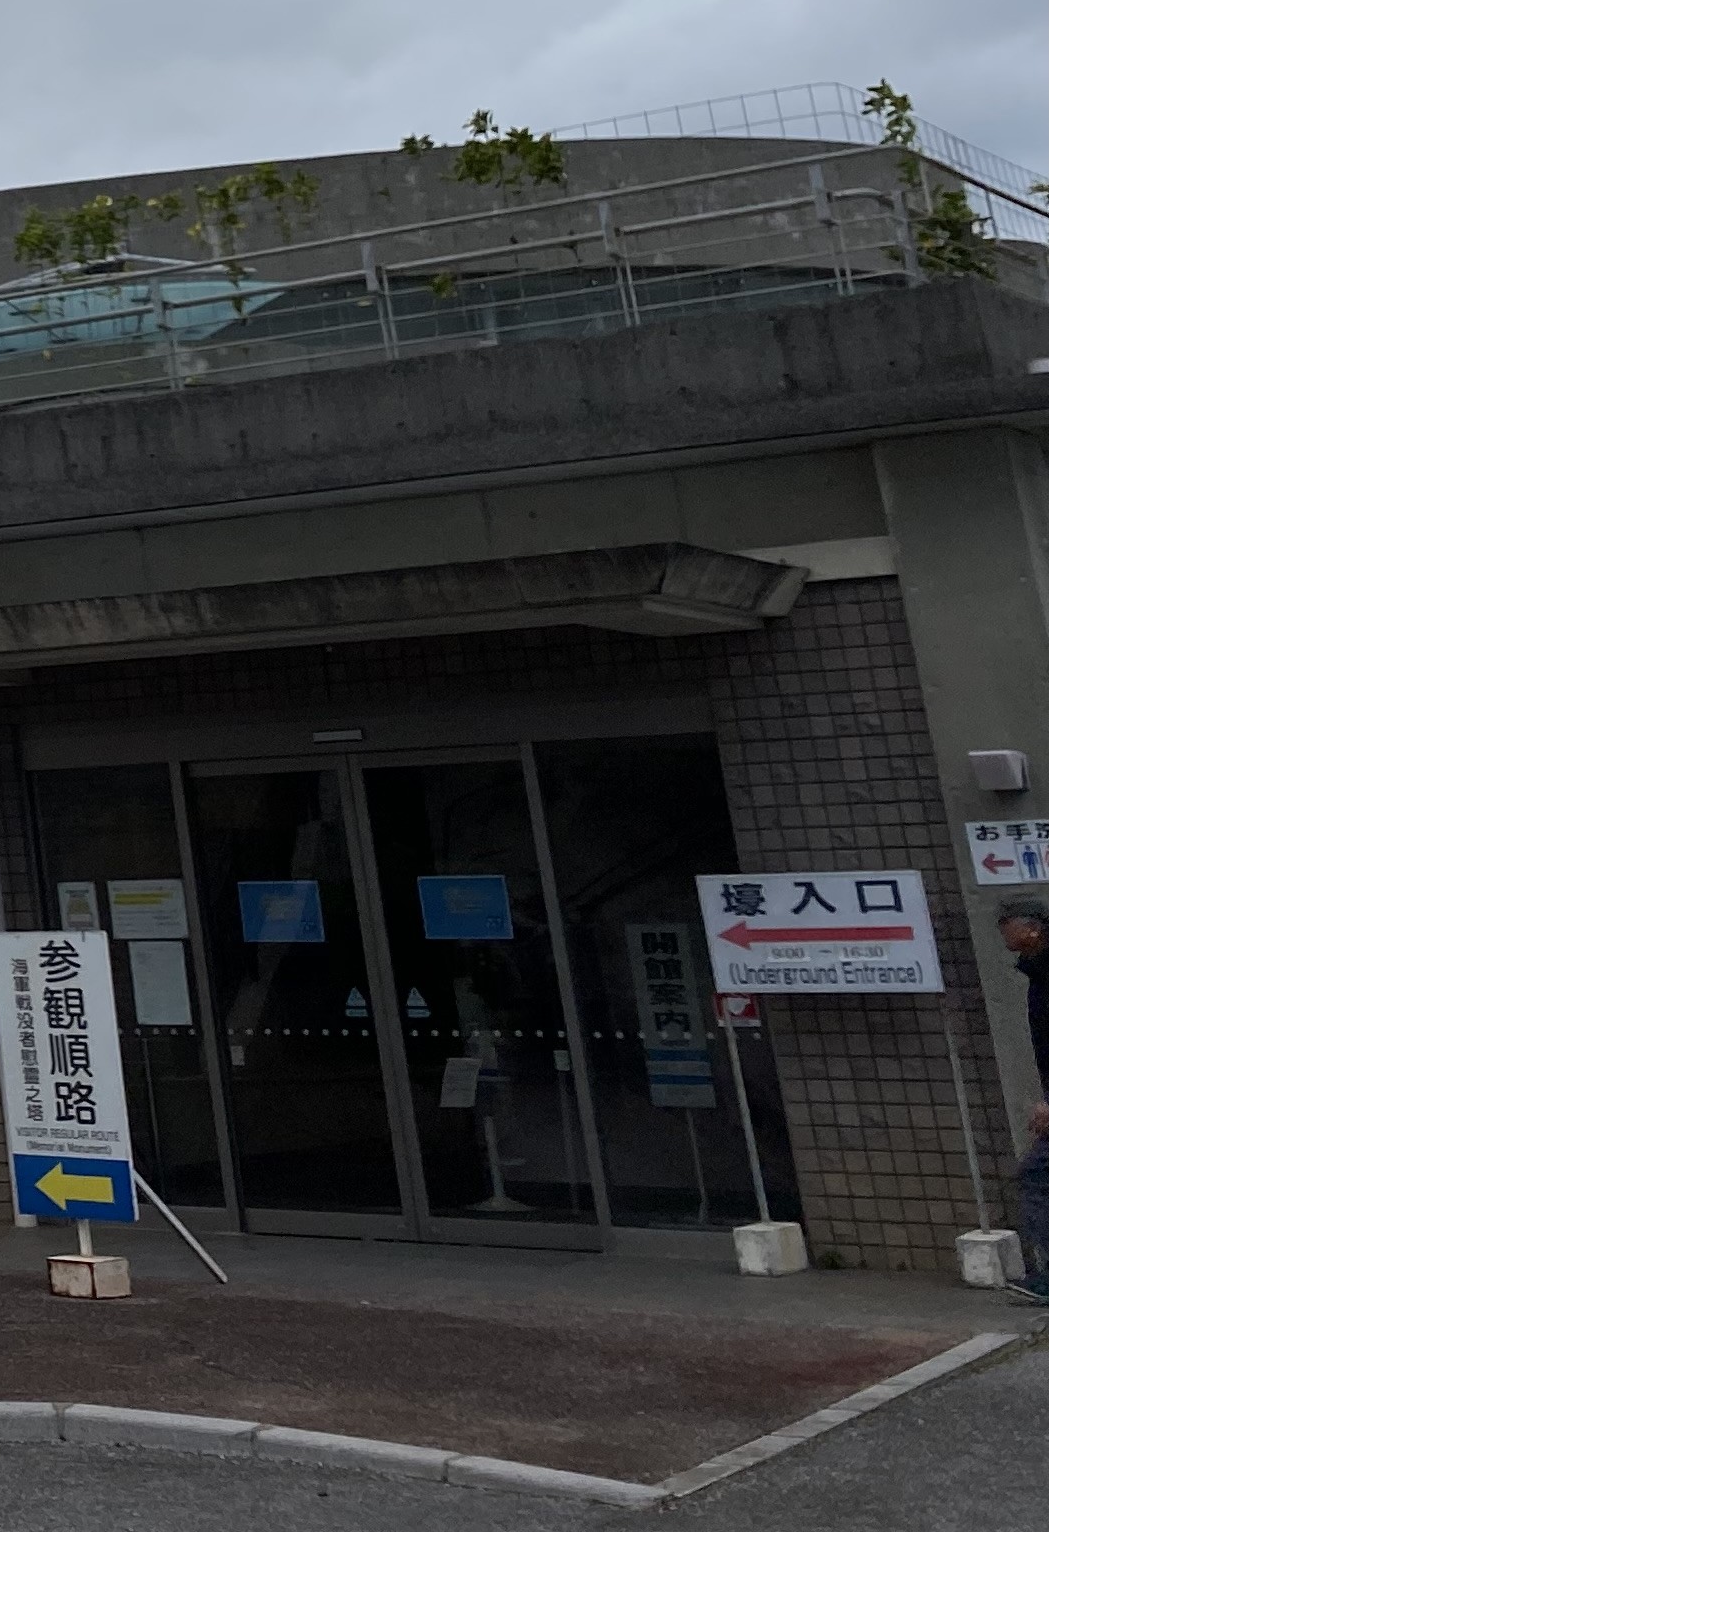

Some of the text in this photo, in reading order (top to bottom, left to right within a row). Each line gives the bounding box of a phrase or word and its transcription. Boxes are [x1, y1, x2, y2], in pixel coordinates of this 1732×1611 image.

[721, 879, 904, 917] 壕入口
[730, 960, 924, 985] (Underground Entrance)
[39, 940, 97, 1125] 参観順路
[16, 1127, 120, 1143] VISITOR REGULAR ROUTE
